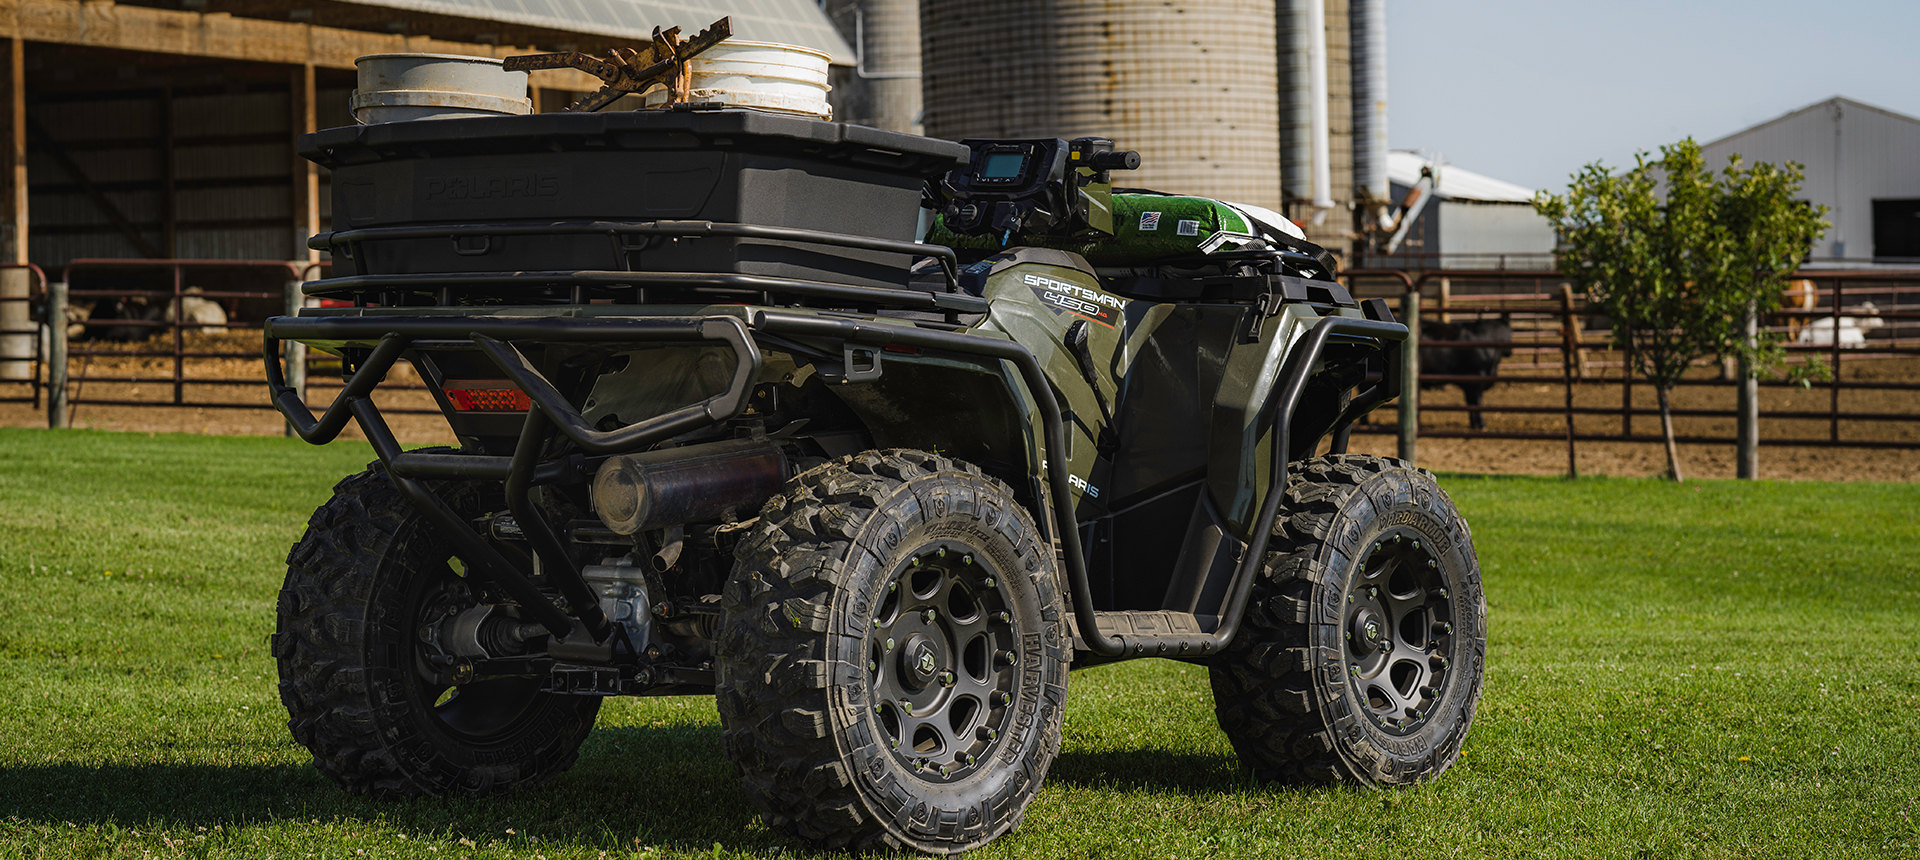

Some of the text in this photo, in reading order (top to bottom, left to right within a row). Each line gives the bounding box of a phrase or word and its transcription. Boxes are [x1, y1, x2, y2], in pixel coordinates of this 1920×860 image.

[424, 174, 561, 201] POLARIS
[1024, 273, 1127, 310] SPORTSMAN
[1043, 291, 1100, 316] 450
[1042, 460, 1100, 499] PARIS
[997, 631, 1043, 766] HARVESTER
